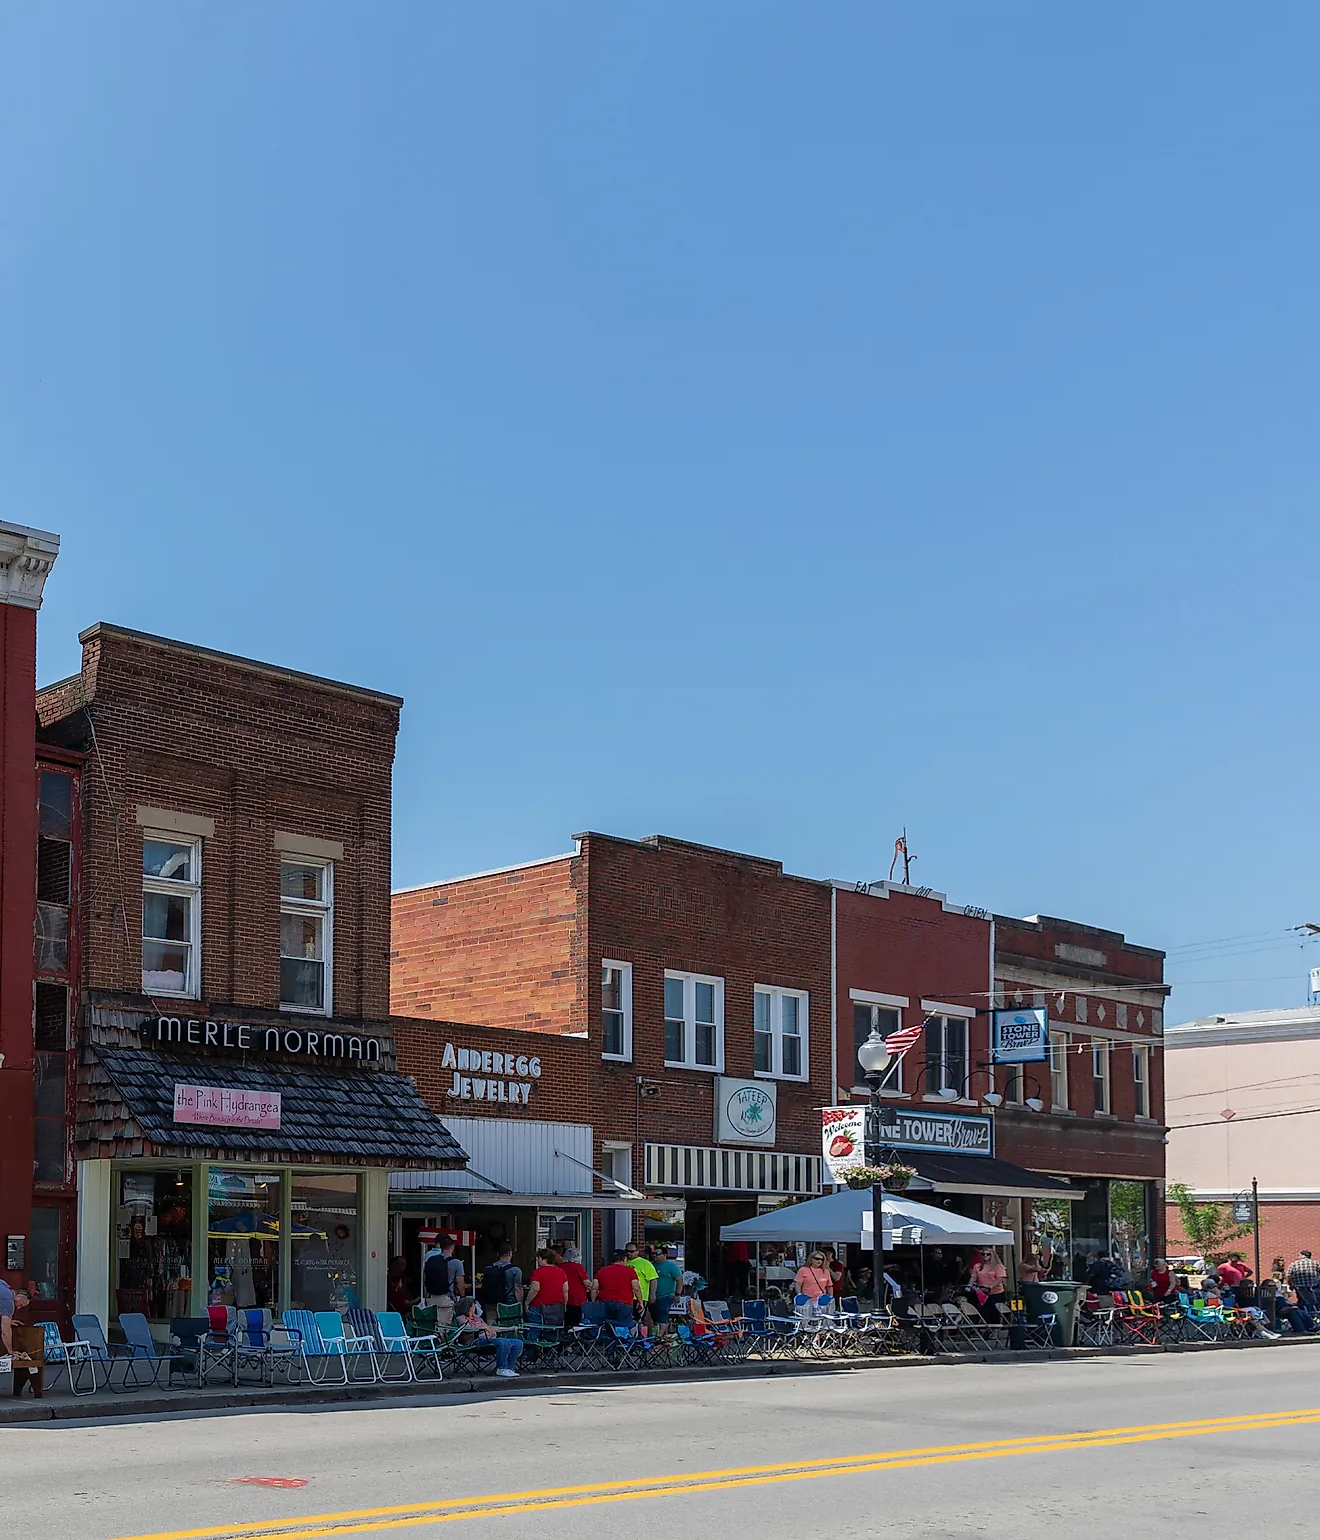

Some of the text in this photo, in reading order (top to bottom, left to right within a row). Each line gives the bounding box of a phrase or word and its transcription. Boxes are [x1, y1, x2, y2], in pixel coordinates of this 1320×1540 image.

[157, 1016, 380, 1061] MERLE NORMAN
[1001, 1032, 1039, 1040] TOWER
[1002, 1024, 1039, 1034] STONE
[441, 1042, 542, 1079] ANDEREGG
[447, 1071, 531, 1105] JEWELRY
[177, 1089, 279, 1118] the Pink Hydrangea
[824, 1121, 862, 1141] Welcome
[904, 1120, 953, 1143] TOWER
[949, 1118, 988, 1149] Brews
